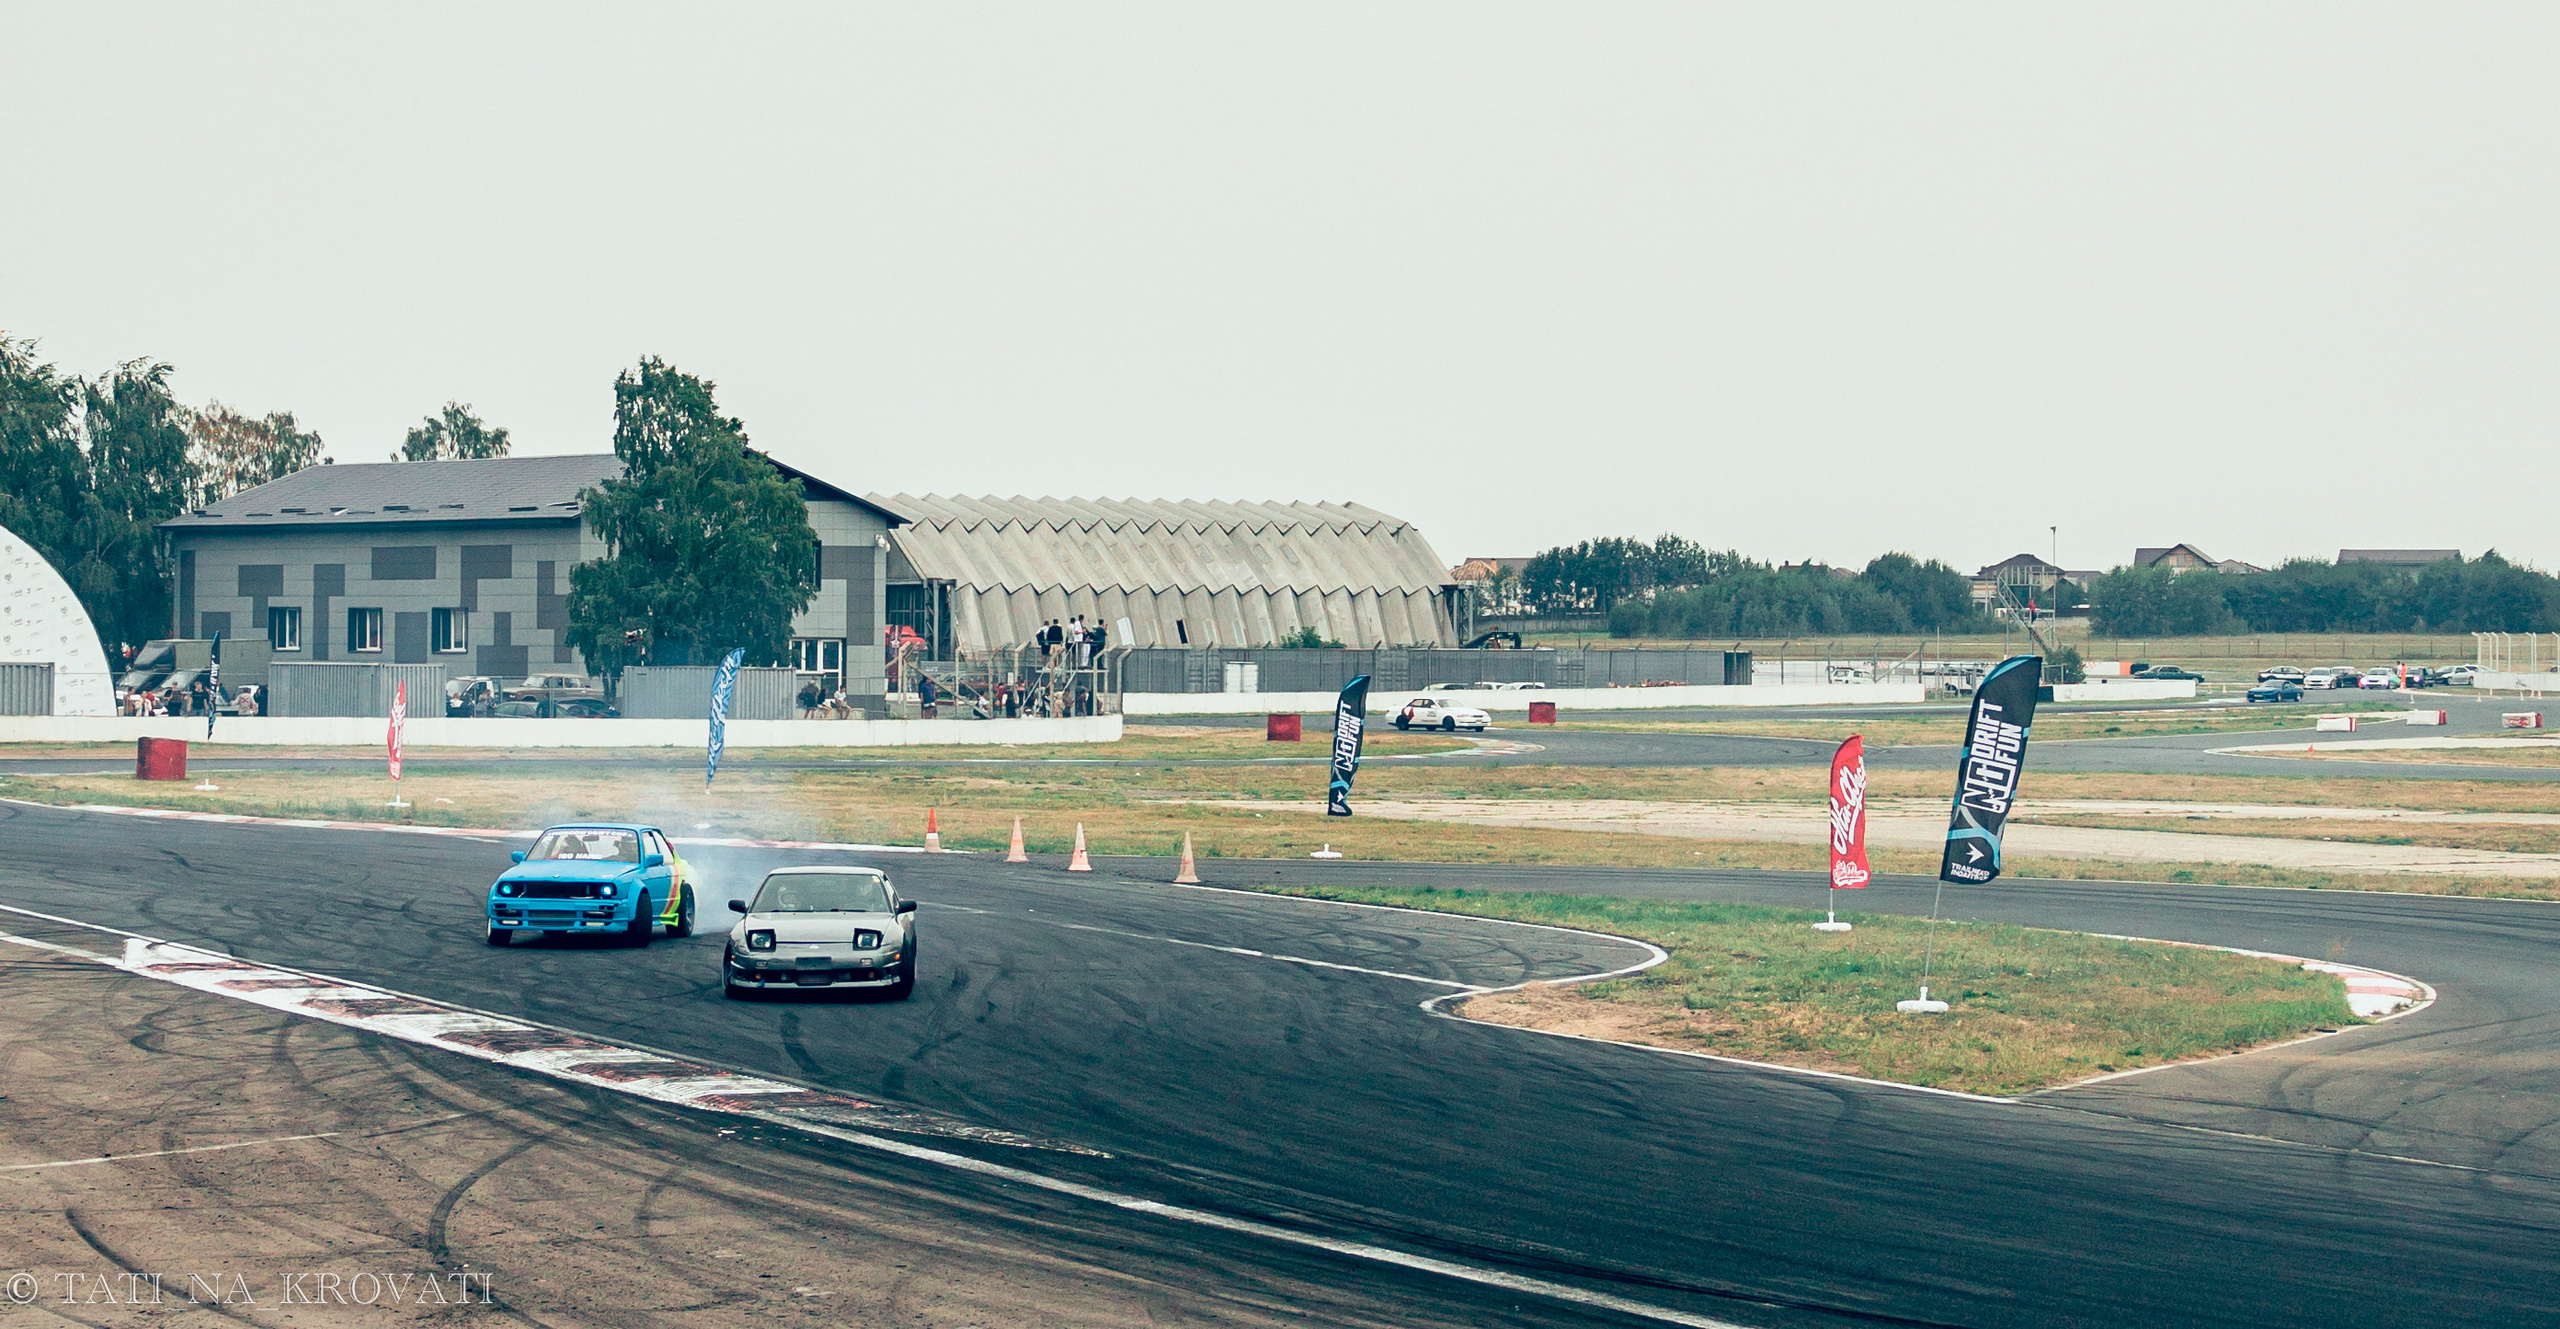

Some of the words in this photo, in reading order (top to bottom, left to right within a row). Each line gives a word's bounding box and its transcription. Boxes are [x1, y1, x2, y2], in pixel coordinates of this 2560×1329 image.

[1338, 700, 1352, 737] DRIFT
[1348, 715, 1362, 742] FUN
[1970, 698, 2003, 760] DRIFT
[1994, 722, 2022, 765] FUN
[1961, 756, 2017, 814] NO
